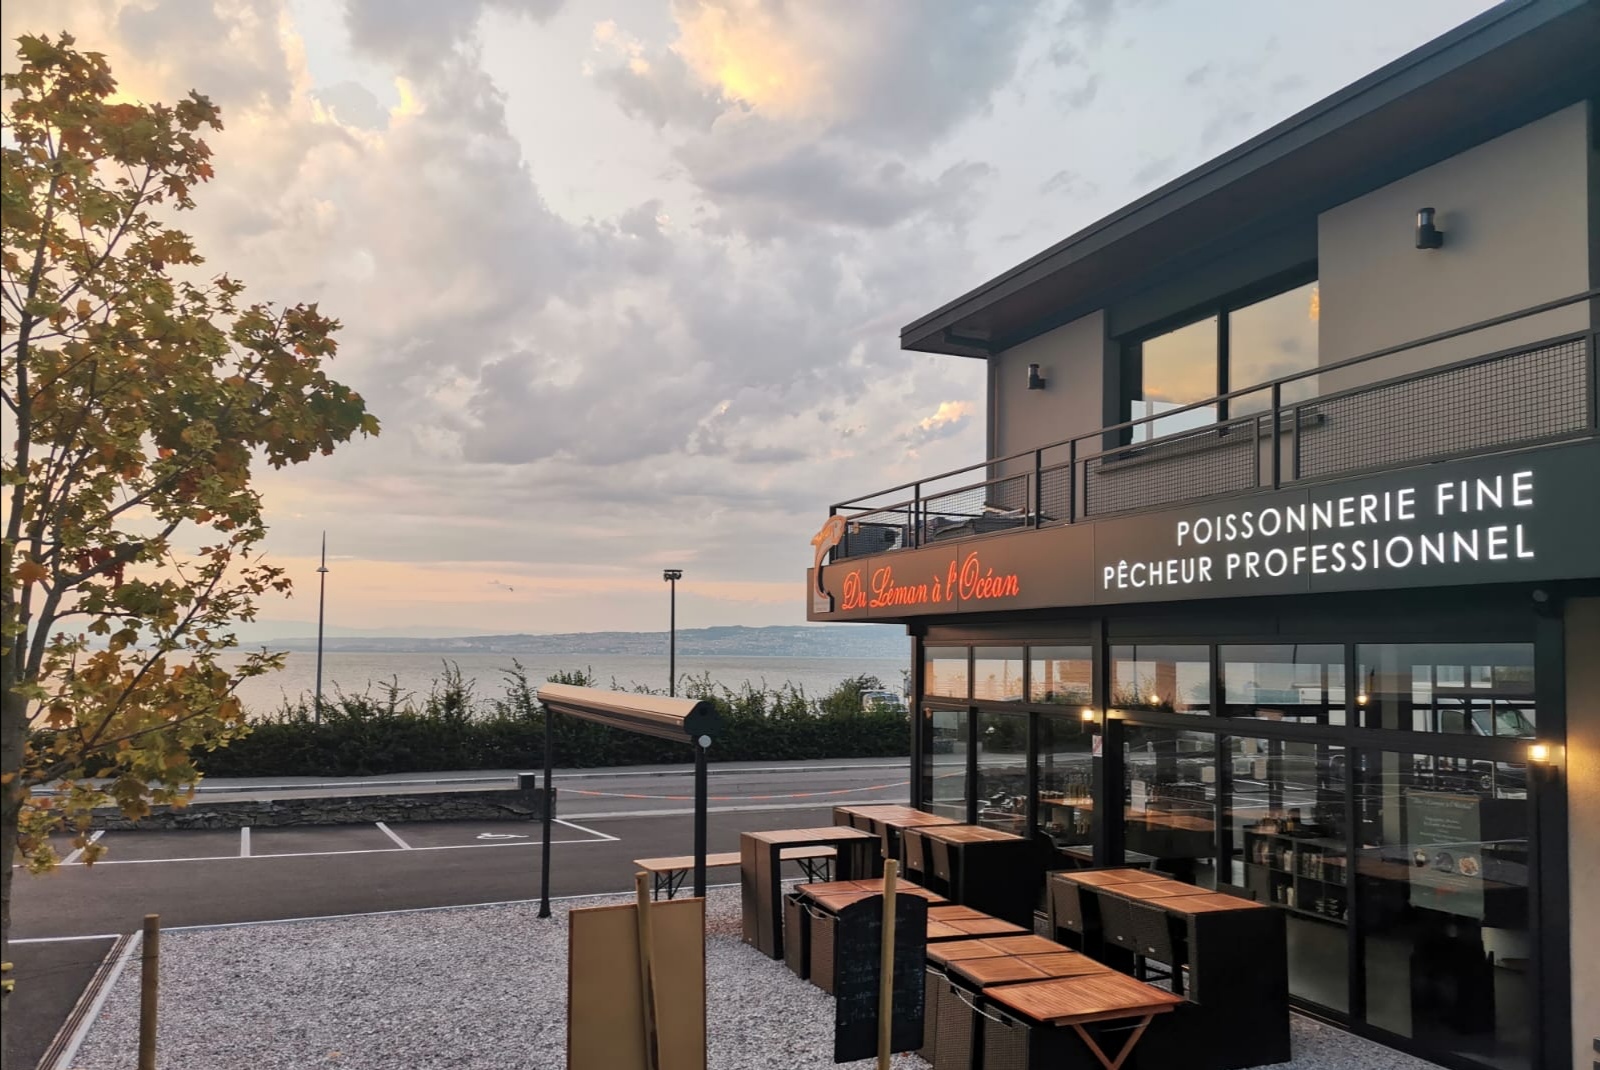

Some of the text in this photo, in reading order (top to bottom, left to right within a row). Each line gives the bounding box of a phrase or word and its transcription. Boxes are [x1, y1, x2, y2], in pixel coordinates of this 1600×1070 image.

[1176, 470, 1536, 547] POISSONNERIE FINE
[842, 551, 1019, 610] Du Léman à l'Océan
[1103, 524, 1536, 590] PÊCHEUR PROFESSIONNEL
